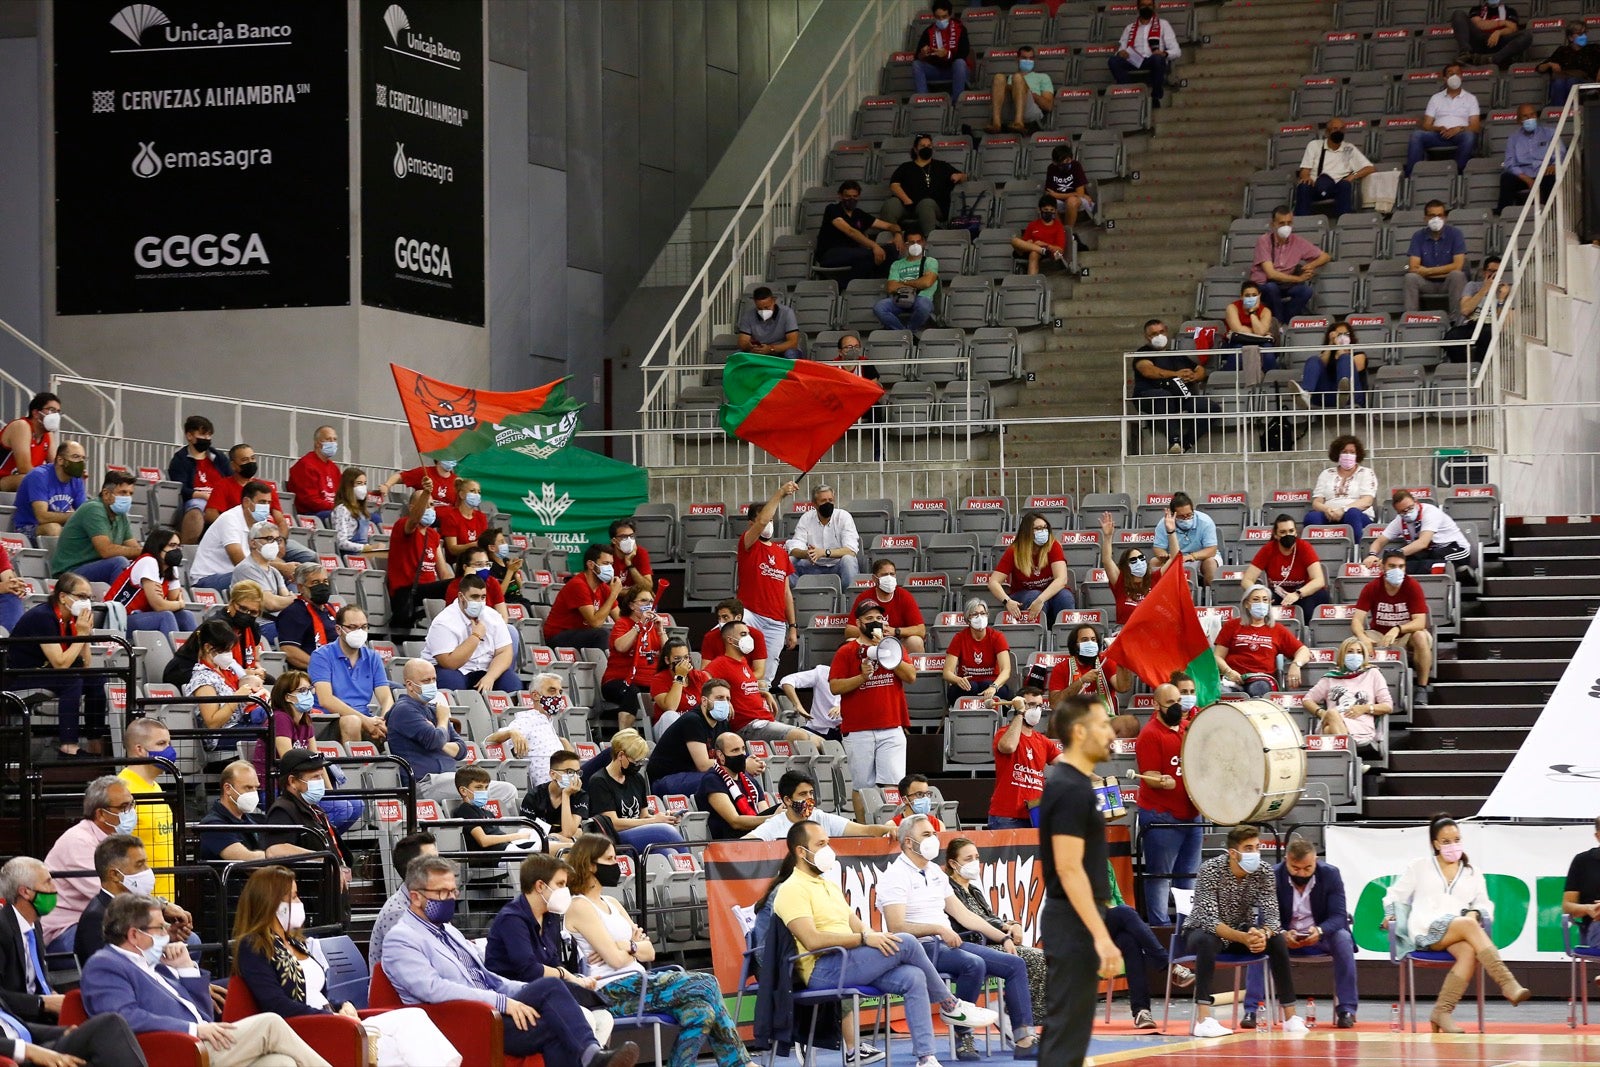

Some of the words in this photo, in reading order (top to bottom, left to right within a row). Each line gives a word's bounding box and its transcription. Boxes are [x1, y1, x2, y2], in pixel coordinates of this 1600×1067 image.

[165, 21, 234, 44] Unicaja
[236, 23, 292, 40] Banco
[407, 31, 437, 59] Unicaja
[437, 42, 461, 63] Banco
[121, 89, 201, 111] CERVEZAS
[204, 84, 296, 108] ALHAMBRA
[296, 83, 311, 95] SIN
[388, 89, 423, 117] CERVEZAS
[423, 99, 464, 127] ALHAMBRA
[164, 148, 272, 170] emasagra
[407, 156, 453, 184] emasagra
[428, 413, 476, 429] FCBG
[1309, 739, 1321, 747] NO
